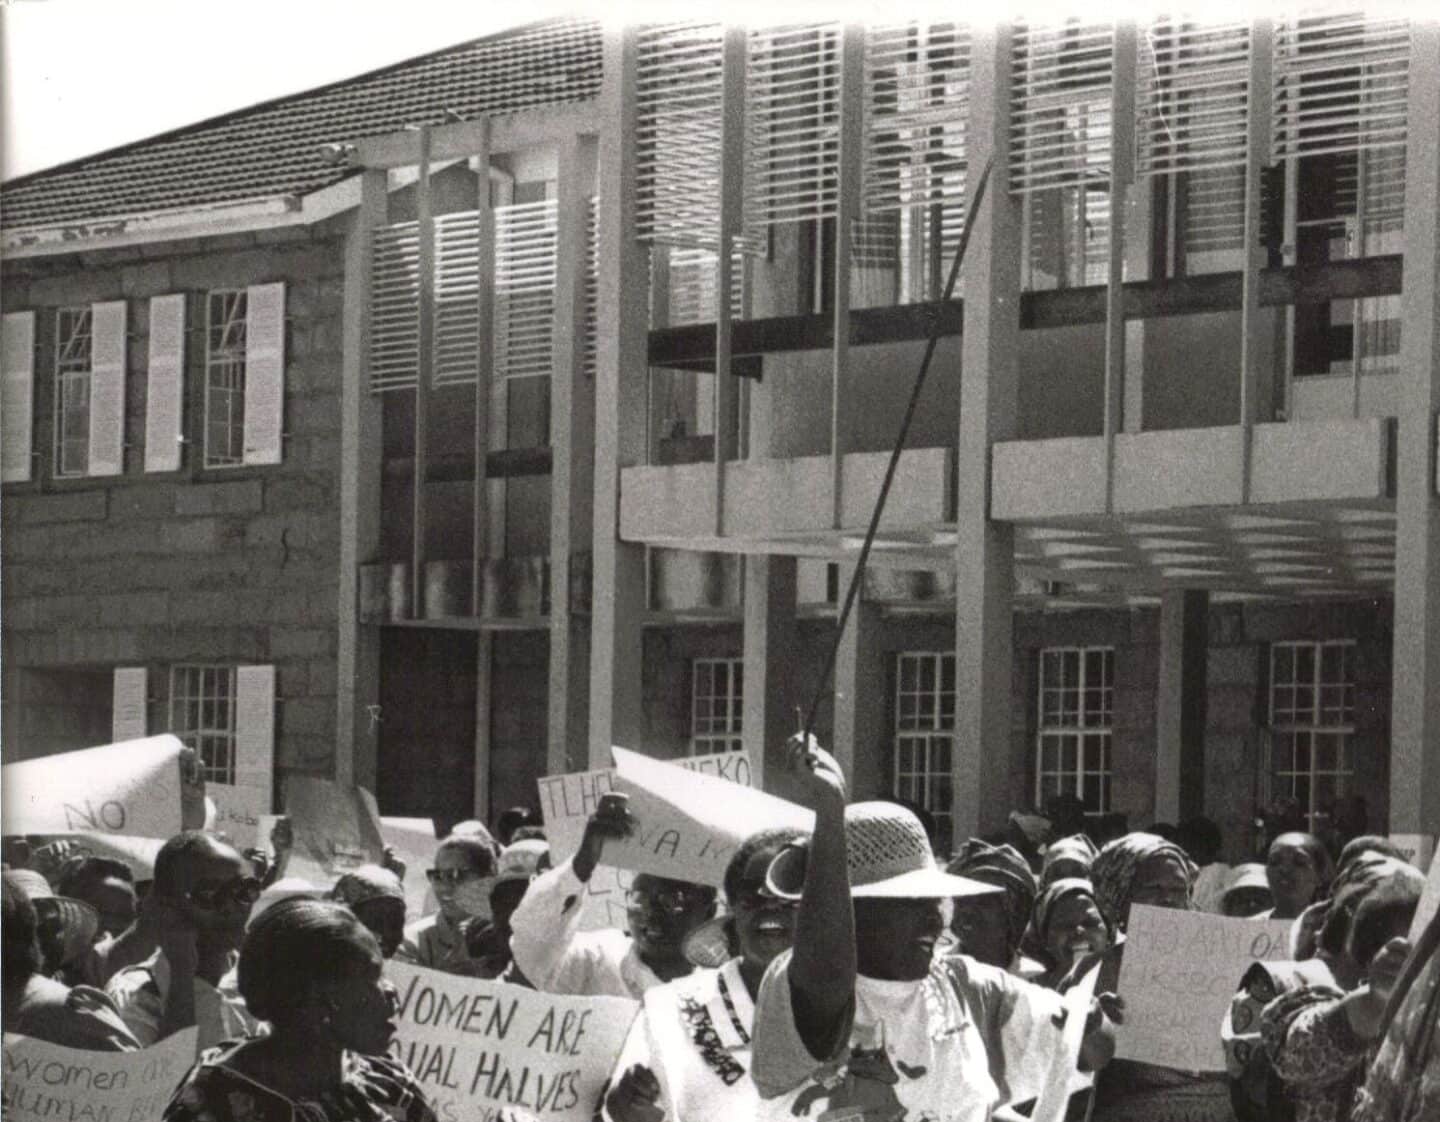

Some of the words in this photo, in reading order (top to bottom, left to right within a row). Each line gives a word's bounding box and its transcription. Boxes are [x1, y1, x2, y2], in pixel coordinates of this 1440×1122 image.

[64, 799, 126, 831] NO
[526, 1005, 593, 1056] ARE
[469, 1050, 580, 1113] HALVES
